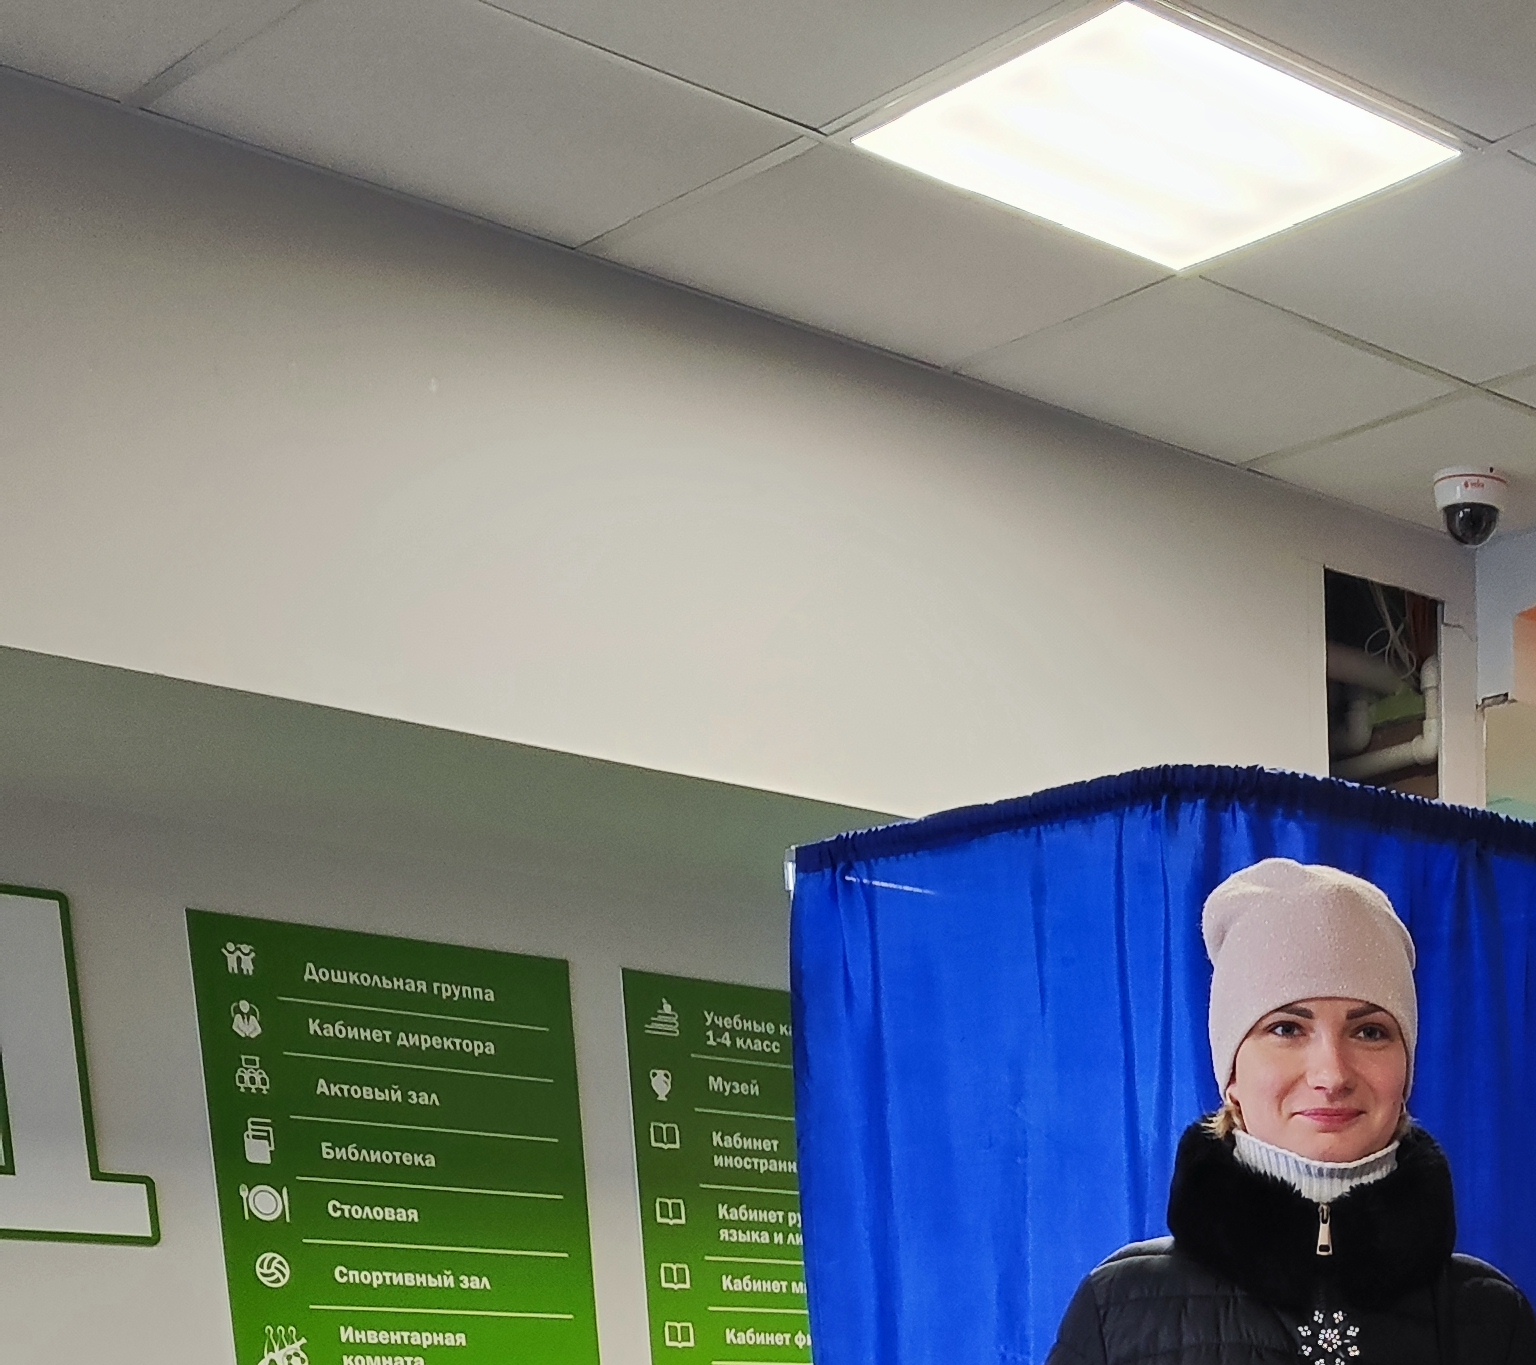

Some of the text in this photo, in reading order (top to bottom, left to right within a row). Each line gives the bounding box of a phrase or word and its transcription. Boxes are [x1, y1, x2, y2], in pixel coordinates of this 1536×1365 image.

[303, 962, 495, 1002] Дошкольная группа
[704, 1010, 775, 1034] Учебные
[308, 1018, 495, 1057] Кабинет директора
[705, 1030, 781, 1053] 1-4 класс
[316, 1078, 440, 1107] Актовый зал
[708, 1075, 760, 1096] Музей
[712, 1131, 779, 1152] Кабинет
[320, 1141, 436, 1168] Библиотека
[713, 1155, 797, 1174] иностранн
[327, 1199, 419, 1222] Столовая
[718, 1203, 784, 1224] Кабинет
[719, 1230, 770, 1244] языка
[773, 1231, 784, 1245] и
[334, 1265, 491, 1290] Спортивный зал
[722, 1274, 788, 1293] Кабинет
[339, 1326, 466, 1348] Инвентарная
[725, 1328, 791, 1345] Кабинет
